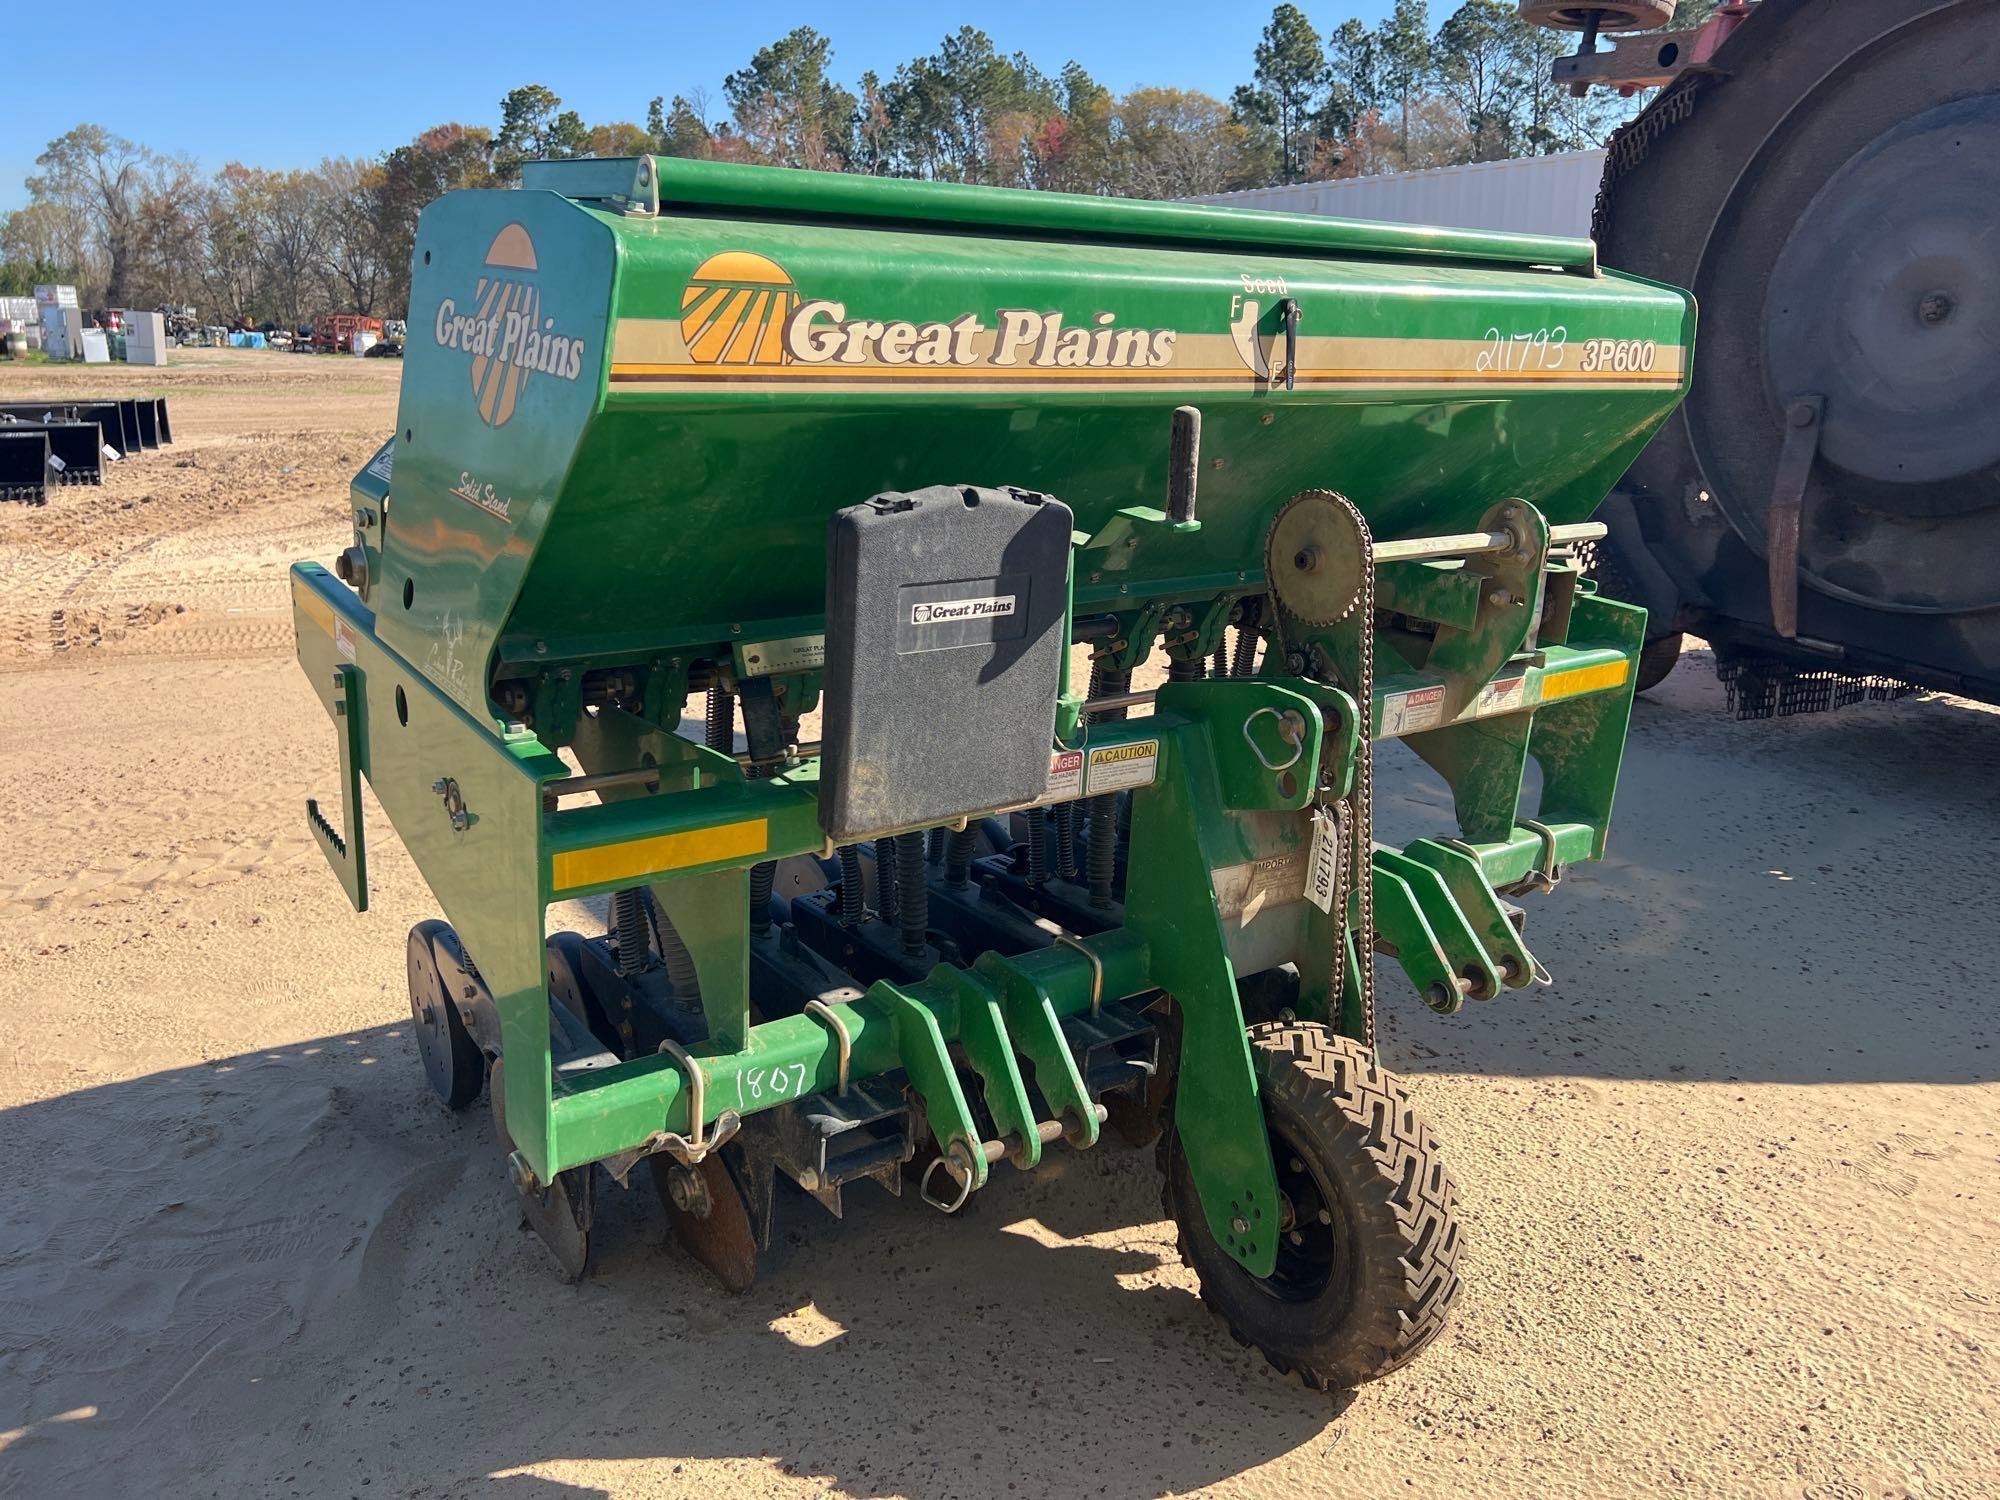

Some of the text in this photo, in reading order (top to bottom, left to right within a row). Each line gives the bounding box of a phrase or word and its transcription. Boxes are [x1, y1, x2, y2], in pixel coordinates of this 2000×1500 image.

[1240, 273, 1288, 295] Seed
[1230, 295, 1241, 318] F
[436, 298, 585, 380] Great Plains
[781, 300, 1177, 368] Great Plains
[1476, 325, 1567, 372] 211793
[1579, 338, 1656, 373] 3P600
[1271, 361, 1282, 382] E
[458, 471, 512, 516] Solid Stand
[933, 601, 1013, 618] Great Plains
[1414, 689, 1443, 704] DANGER
[1050, 754, 1081, 771] ANGER
[1105, 744, 1153, 762] CAUTION
[1315, 834, 1333, 898] 211793
[736, 1063, 806, 1109] 1807
